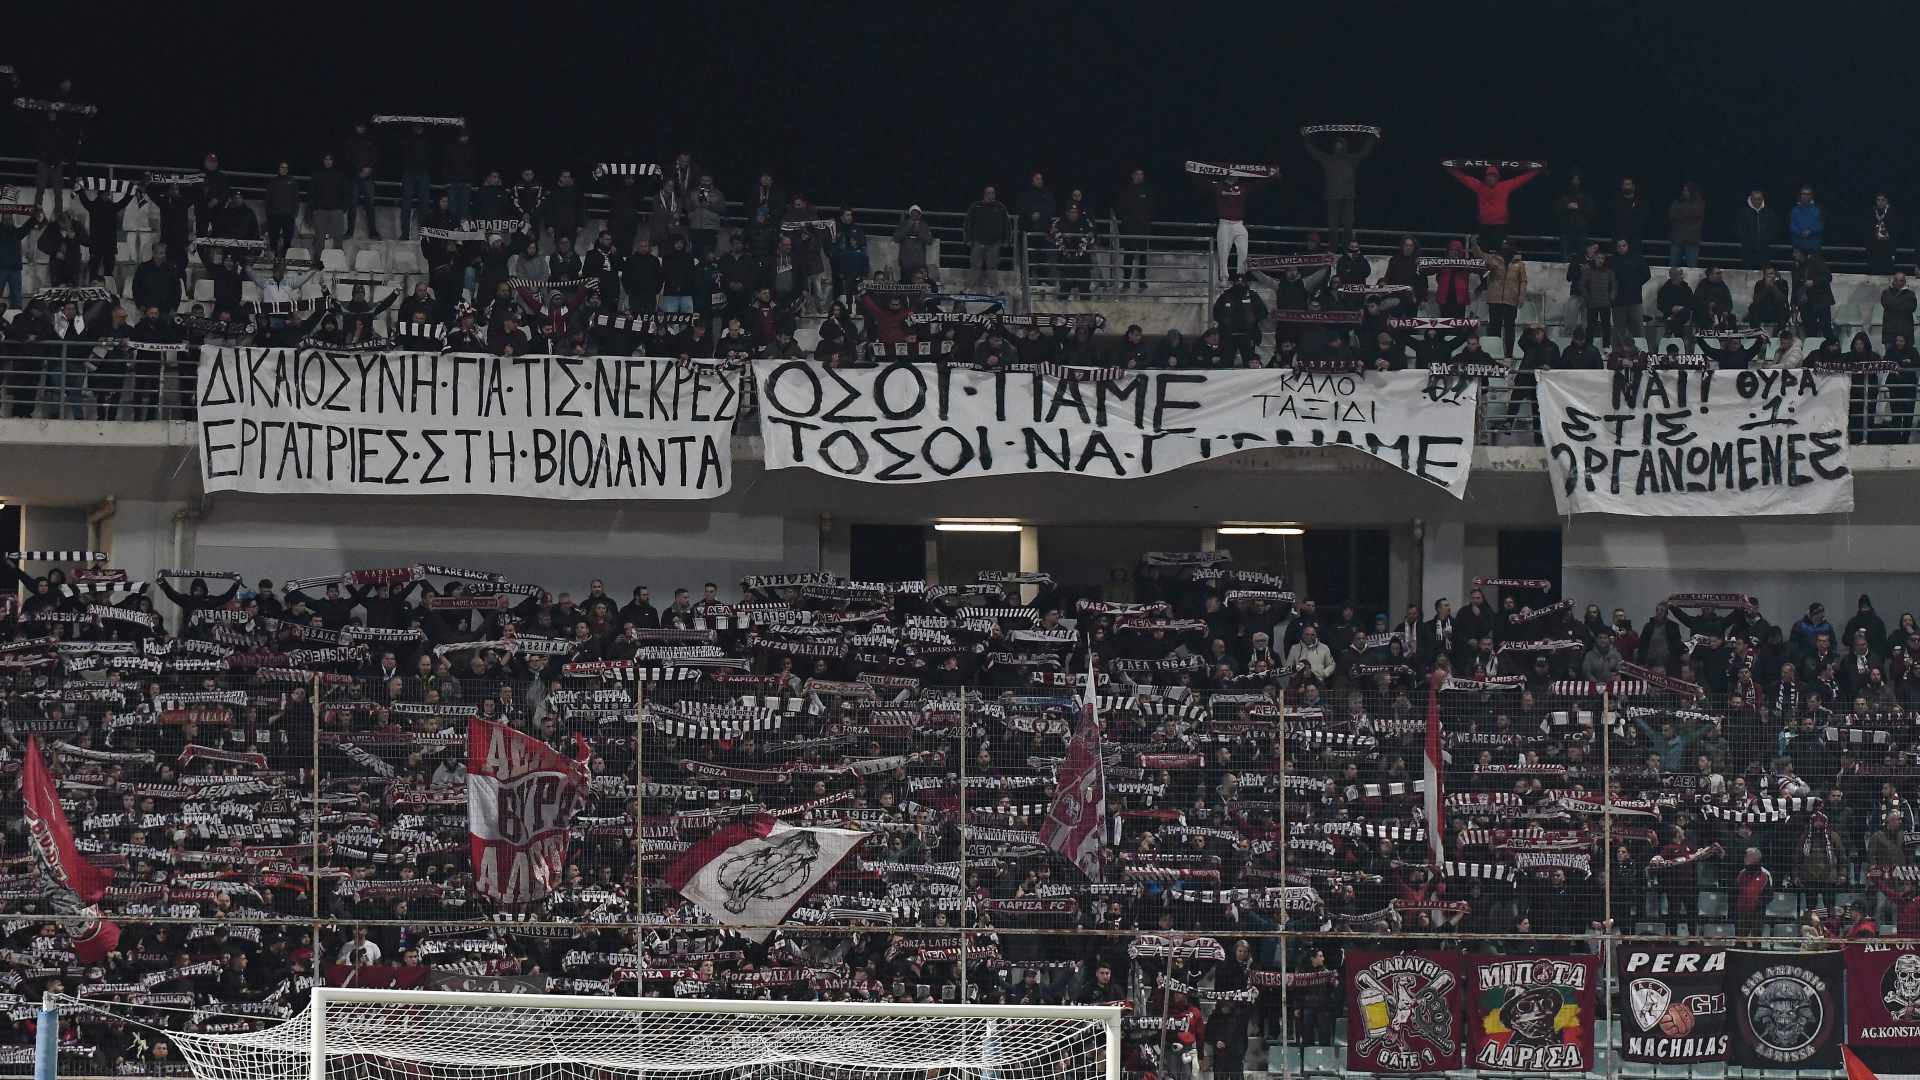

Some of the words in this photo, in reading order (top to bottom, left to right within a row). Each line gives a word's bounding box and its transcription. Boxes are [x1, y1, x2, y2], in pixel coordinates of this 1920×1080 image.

[1229, 163, 1268, 173] LARISSA
[1463, 160, 1493, 168] AEL
[1501, 160, 1520, 168] FC
[933, 312, 960, 322] THE
[1281, 374, 1355, 396] ΚΑΛΟ
[1736, 369, 1818, 400] ΘΥΡΑ
[1252, 395, 1375, 424] ΤΑΞΙΔΙ
[534, 428, 723, 490] ΒΙΟΛΑΝΤΑ
[428, 566, 443, 575] WE
[445, 567, 463, 577] ARE
[465, 569, 489, 580] BACK
[854, 653, 881, 664] AEL
[888, 656, 906, 666] FC
[1156, 659, 1188, 670] 1964
[1485, 674, 1527, 684] LARISSA
[1457, 732, 1470, 743] WE
[1472, 733, 1489, 744] ARE
[1490, 734, 1513, 744] BACK
[699, 766, 728, 778] FORZA
[807, 791, 850, 811] LARISSA
[845, 809, 878, 821] 1964
[253, 850, 283, 858] FORZA
[998, 900, 1043, 911] ΛΑΡΙΣΑ
[1049, 901, 1066, 911] FC
[1257, 899, 1272, 910] WE
[1292, 900, 1318, 913] BACK
[1626, 952, 1725, 973] PERA
[670, 970, 686, 979] FC
[1628, 1034, 1729, 1058] MACHALAS
